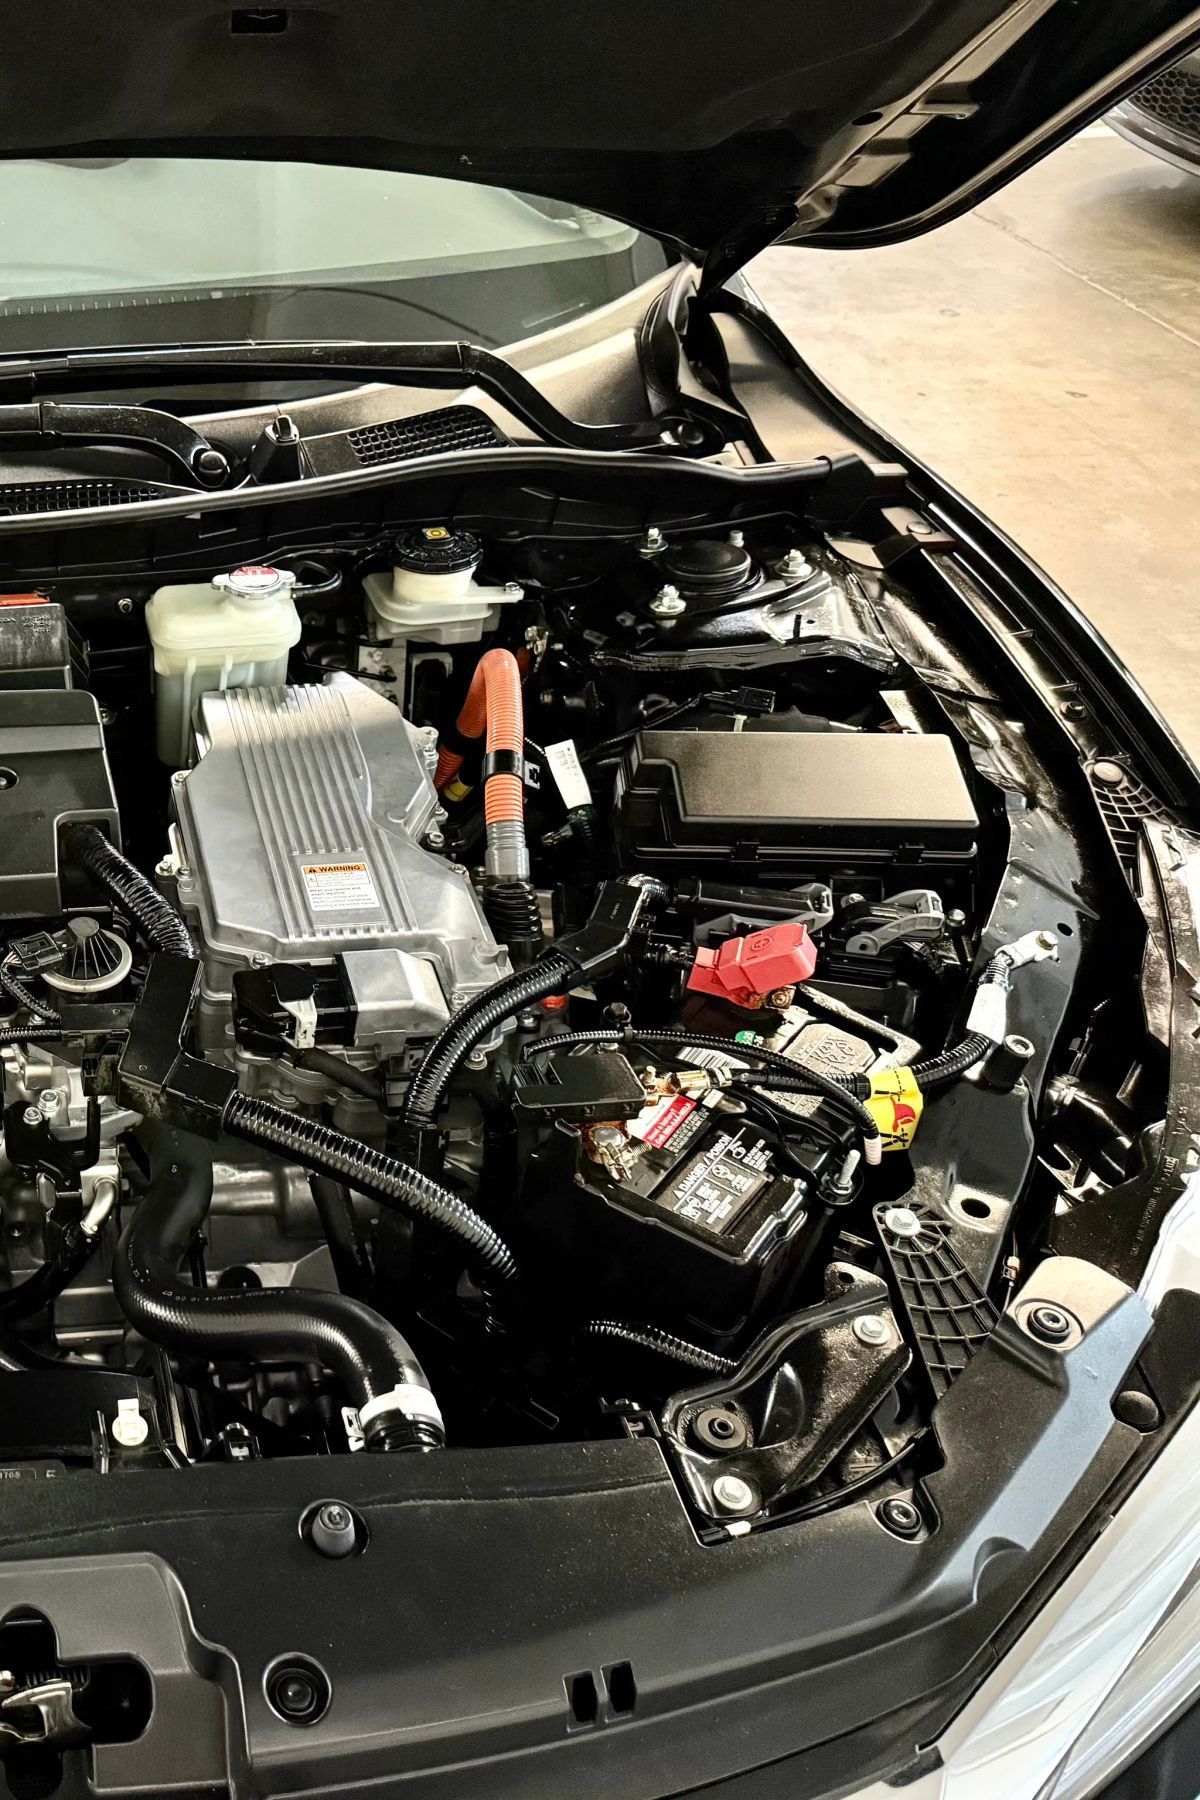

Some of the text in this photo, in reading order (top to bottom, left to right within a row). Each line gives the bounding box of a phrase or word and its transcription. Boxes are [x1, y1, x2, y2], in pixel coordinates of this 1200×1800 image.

[319, 864, 361, 872] WARNING
[678, 1162, 709, 1192] DANGER
[706, 1133, 734, 1160] POISON
